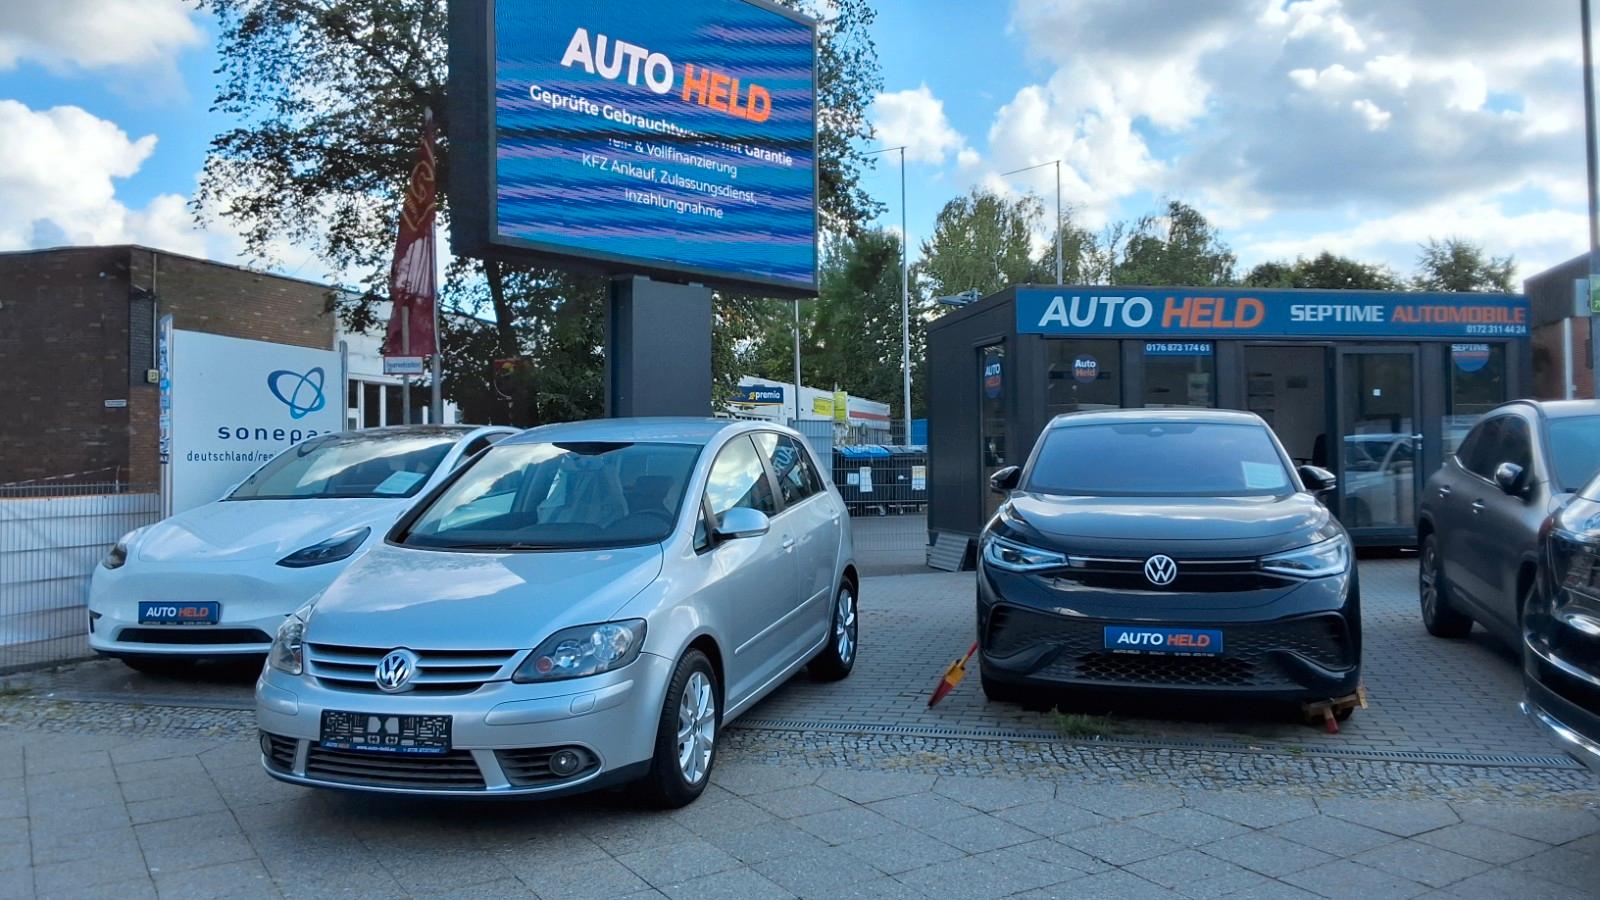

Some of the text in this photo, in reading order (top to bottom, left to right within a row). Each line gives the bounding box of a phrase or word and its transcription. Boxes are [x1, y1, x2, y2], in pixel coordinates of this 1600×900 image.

[560, 27, 773, 123] AUTO HELD
[529, 84, 600, 117] Geprüfte
[646, 142, 738, 179] Vollfinanzierung
[582, 152, 758, 205] KFZ Ankauf, Zulassungsdienst,
[624, 188, 724, 219] Inzahlungnahme
[1038, 296, 1265, 329] AUTO HELD
[1290, 304, 1527, 324] SEPTIME AUTOMOBILE
[1466, 324, 1487, 334] 0172
[1487, 324, 1503, 334] 311
[1504, 325, 1515, 334] 44
[1146, 343, 1210, 352] 0176 873 174 61
[985, 363, 1001, 377] AUTO
[1074, 359, 1097, 368] Auto
[755, 390, 781, 400] premio
[217, 426, 332, 446] sonepa
[146, 606, 209, 617] AUTO HELD
[1117, 631, 1211, 647] AUTO HELD
